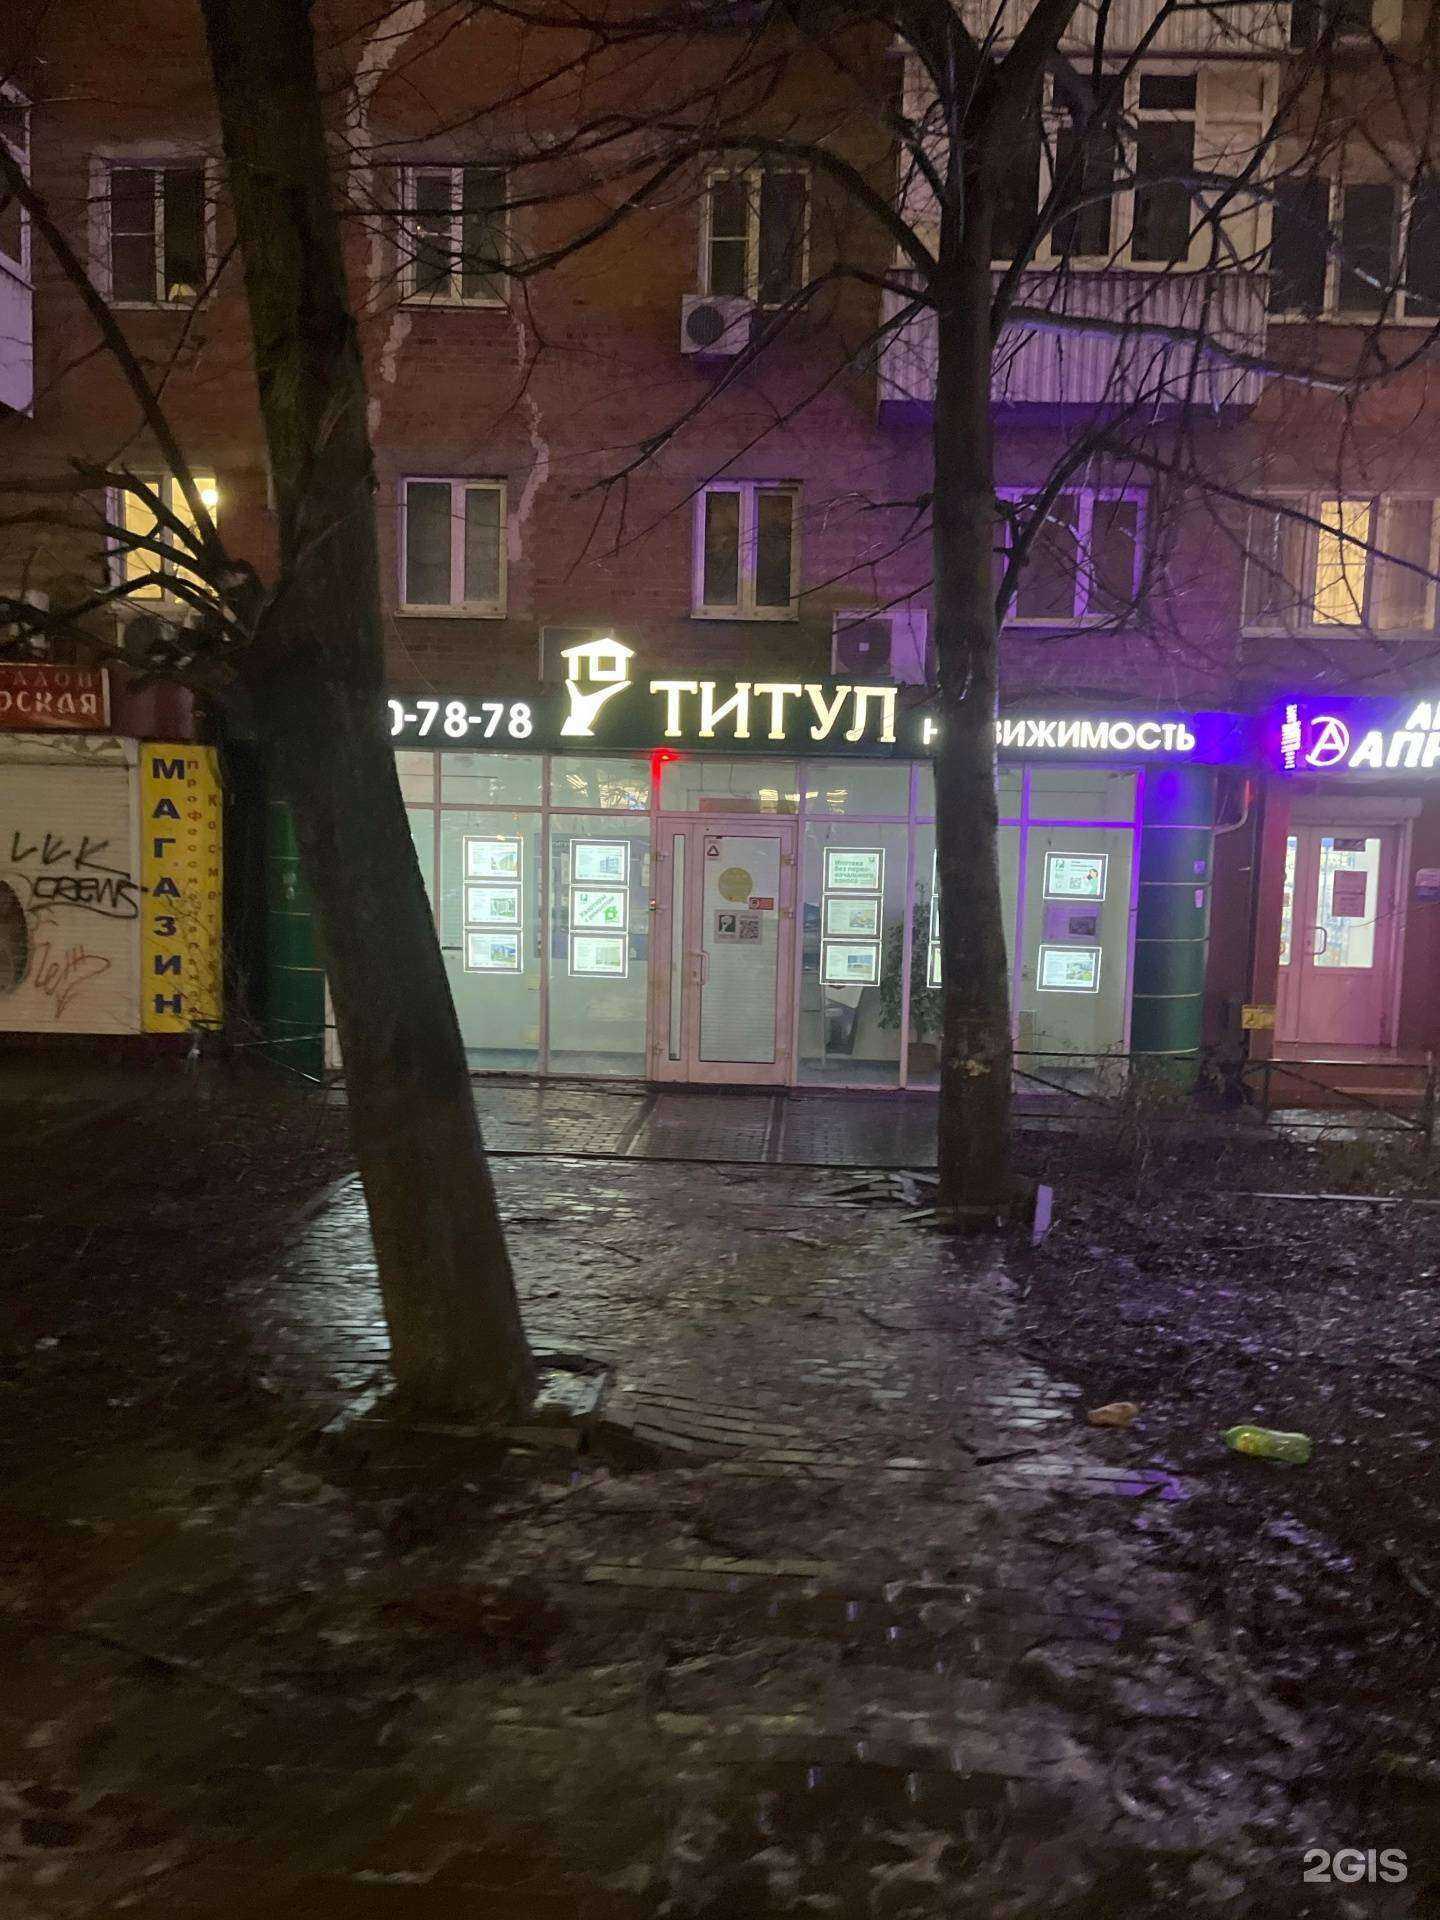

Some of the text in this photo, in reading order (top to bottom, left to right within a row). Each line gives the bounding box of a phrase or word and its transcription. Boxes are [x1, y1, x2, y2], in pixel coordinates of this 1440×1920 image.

[0, 670, 93, 687] АЛОН
[650, 680, 898, 743] ТИТУЛ
[922, 718, 1196, 751] НИЖИМОСТЬ
[151, 758, 186, 1014] МАГАЗИН
